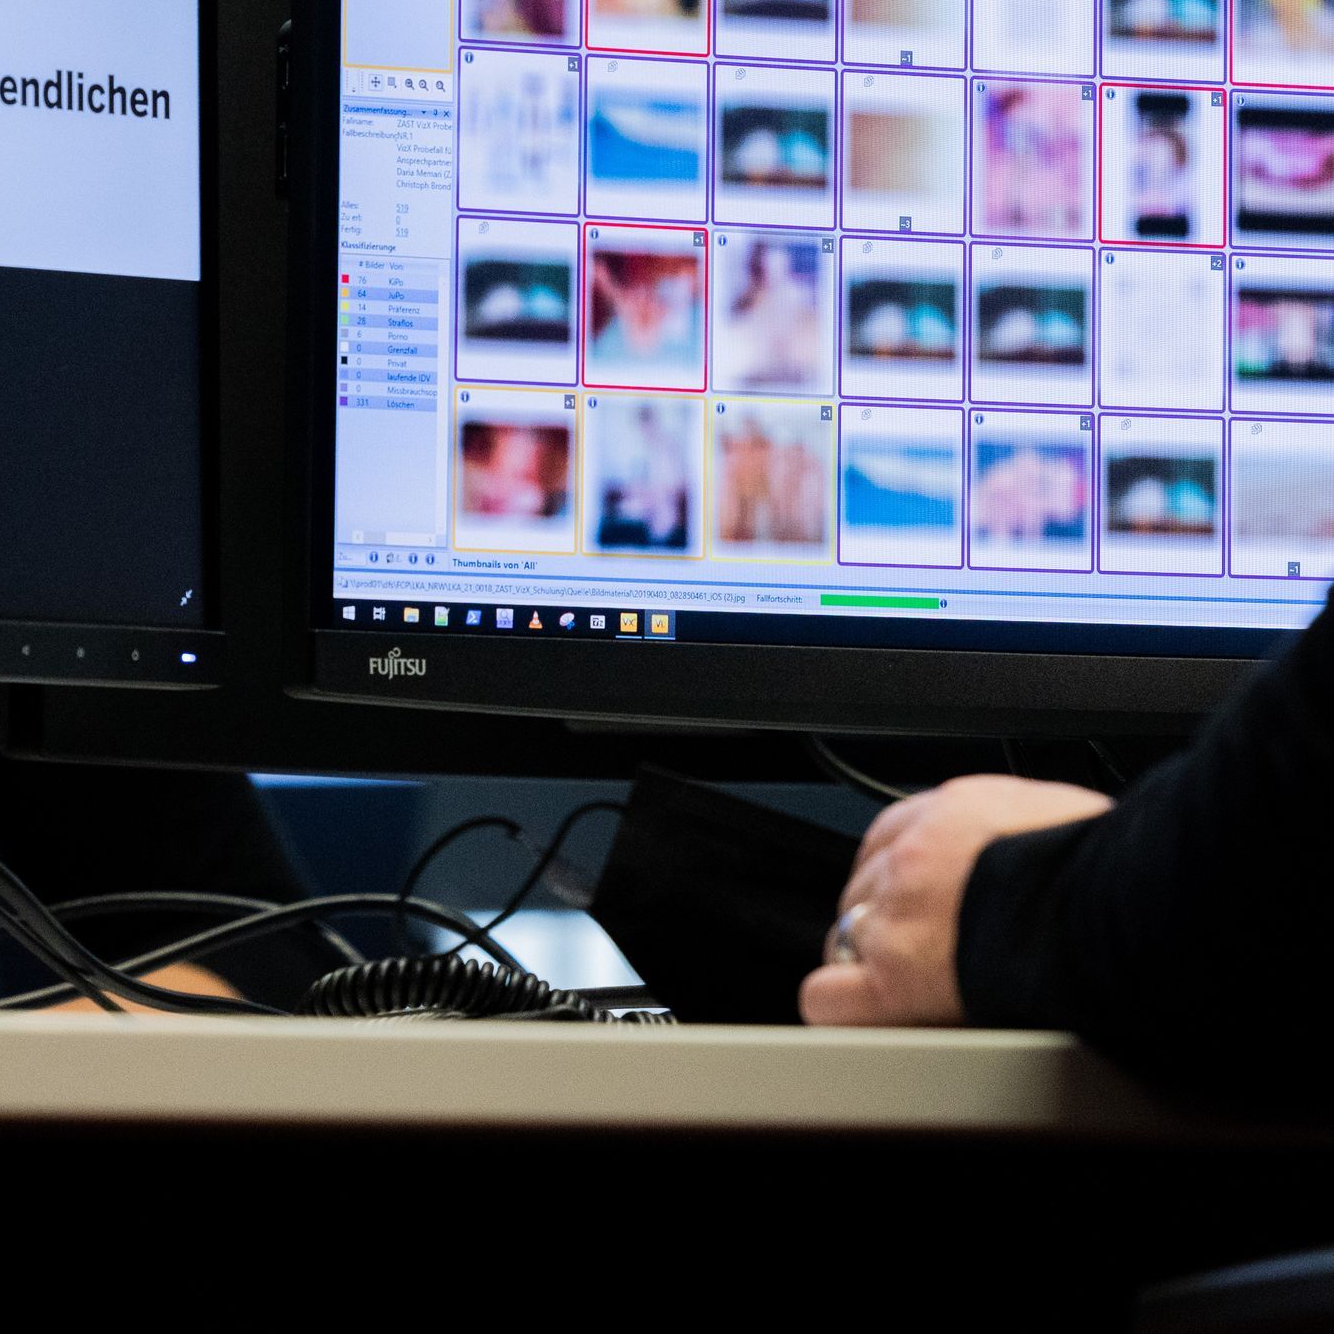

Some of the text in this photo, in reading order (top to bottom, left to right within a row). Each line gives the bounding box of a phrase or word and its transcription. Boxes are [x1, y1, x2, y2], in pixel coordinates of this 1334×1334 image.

[397, 120, 414, 128] ZAST
[397, 144, 412, 152] VizX
[413, 145, 443, 154] Probefall
[396, 180, 429, 190] Christoph
[389, 278, 403, 286] KiPo
[388, 292, 404, 300] JuPo
[388, 305, 419, 314] Präferenz
[388, 318, 413, 327] Straflos
[388, 346, 417, 354] Grenzfall
[388, 359, 407, 367] Privat
[388, 373, 416, 381] laufende
[387, 400, 414, 408] Löschen
[453, 559, 501, 568] Thumbnails
[369, 647, 426, 679] FUJITSU
